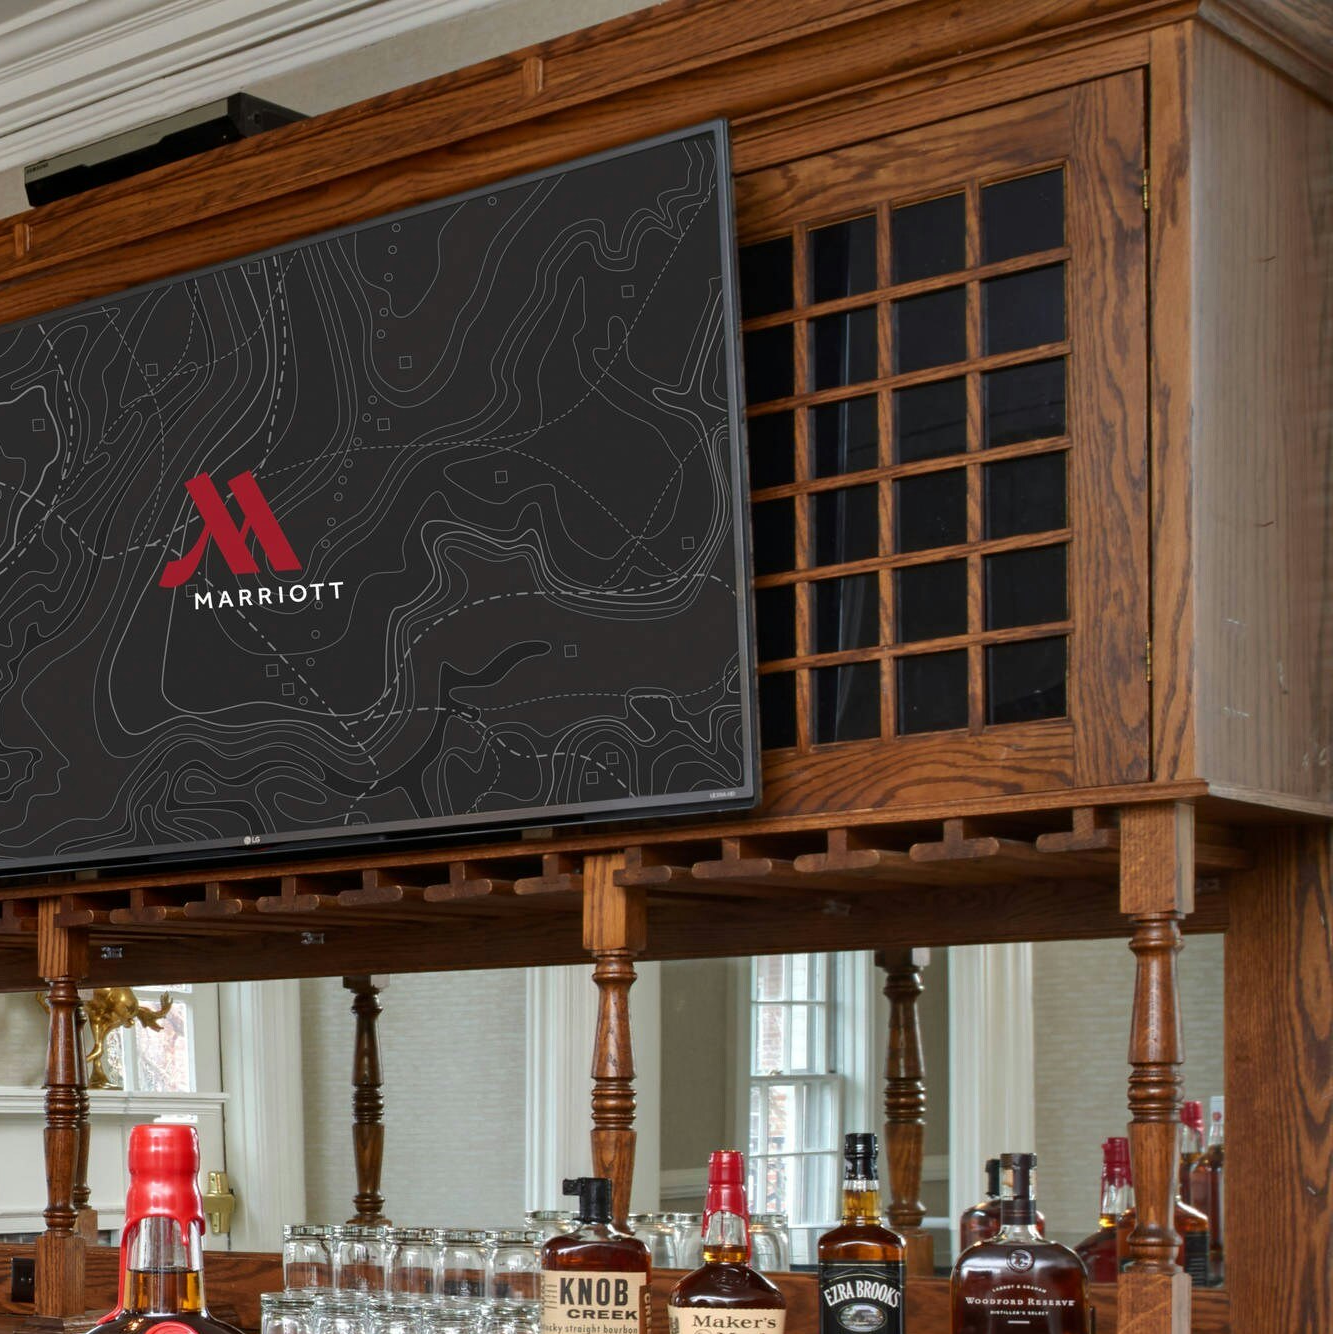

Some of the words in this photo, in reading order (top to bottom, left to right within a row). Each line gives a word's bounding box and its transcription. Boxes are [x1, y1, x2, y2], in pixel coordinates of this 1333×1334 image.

[194, 581, 344, 610] MARRIOTT
[559, 1277, 629, 1306] KNOB
[823, 1281, 855, 1307] EZRA
[855, 1280, 901, 1308] BROOKS
[965, 1296, 1024, 1306] WOODFORD
[1027, 1297, 1075, 1307] RESERVE
[567, 1309, 638, 1320] CREEK
[565, 1324, 600, 1334] straight
[603, 1324, 638, 1334] bourbon
[692, 1315, 776, 1329] Maker's
